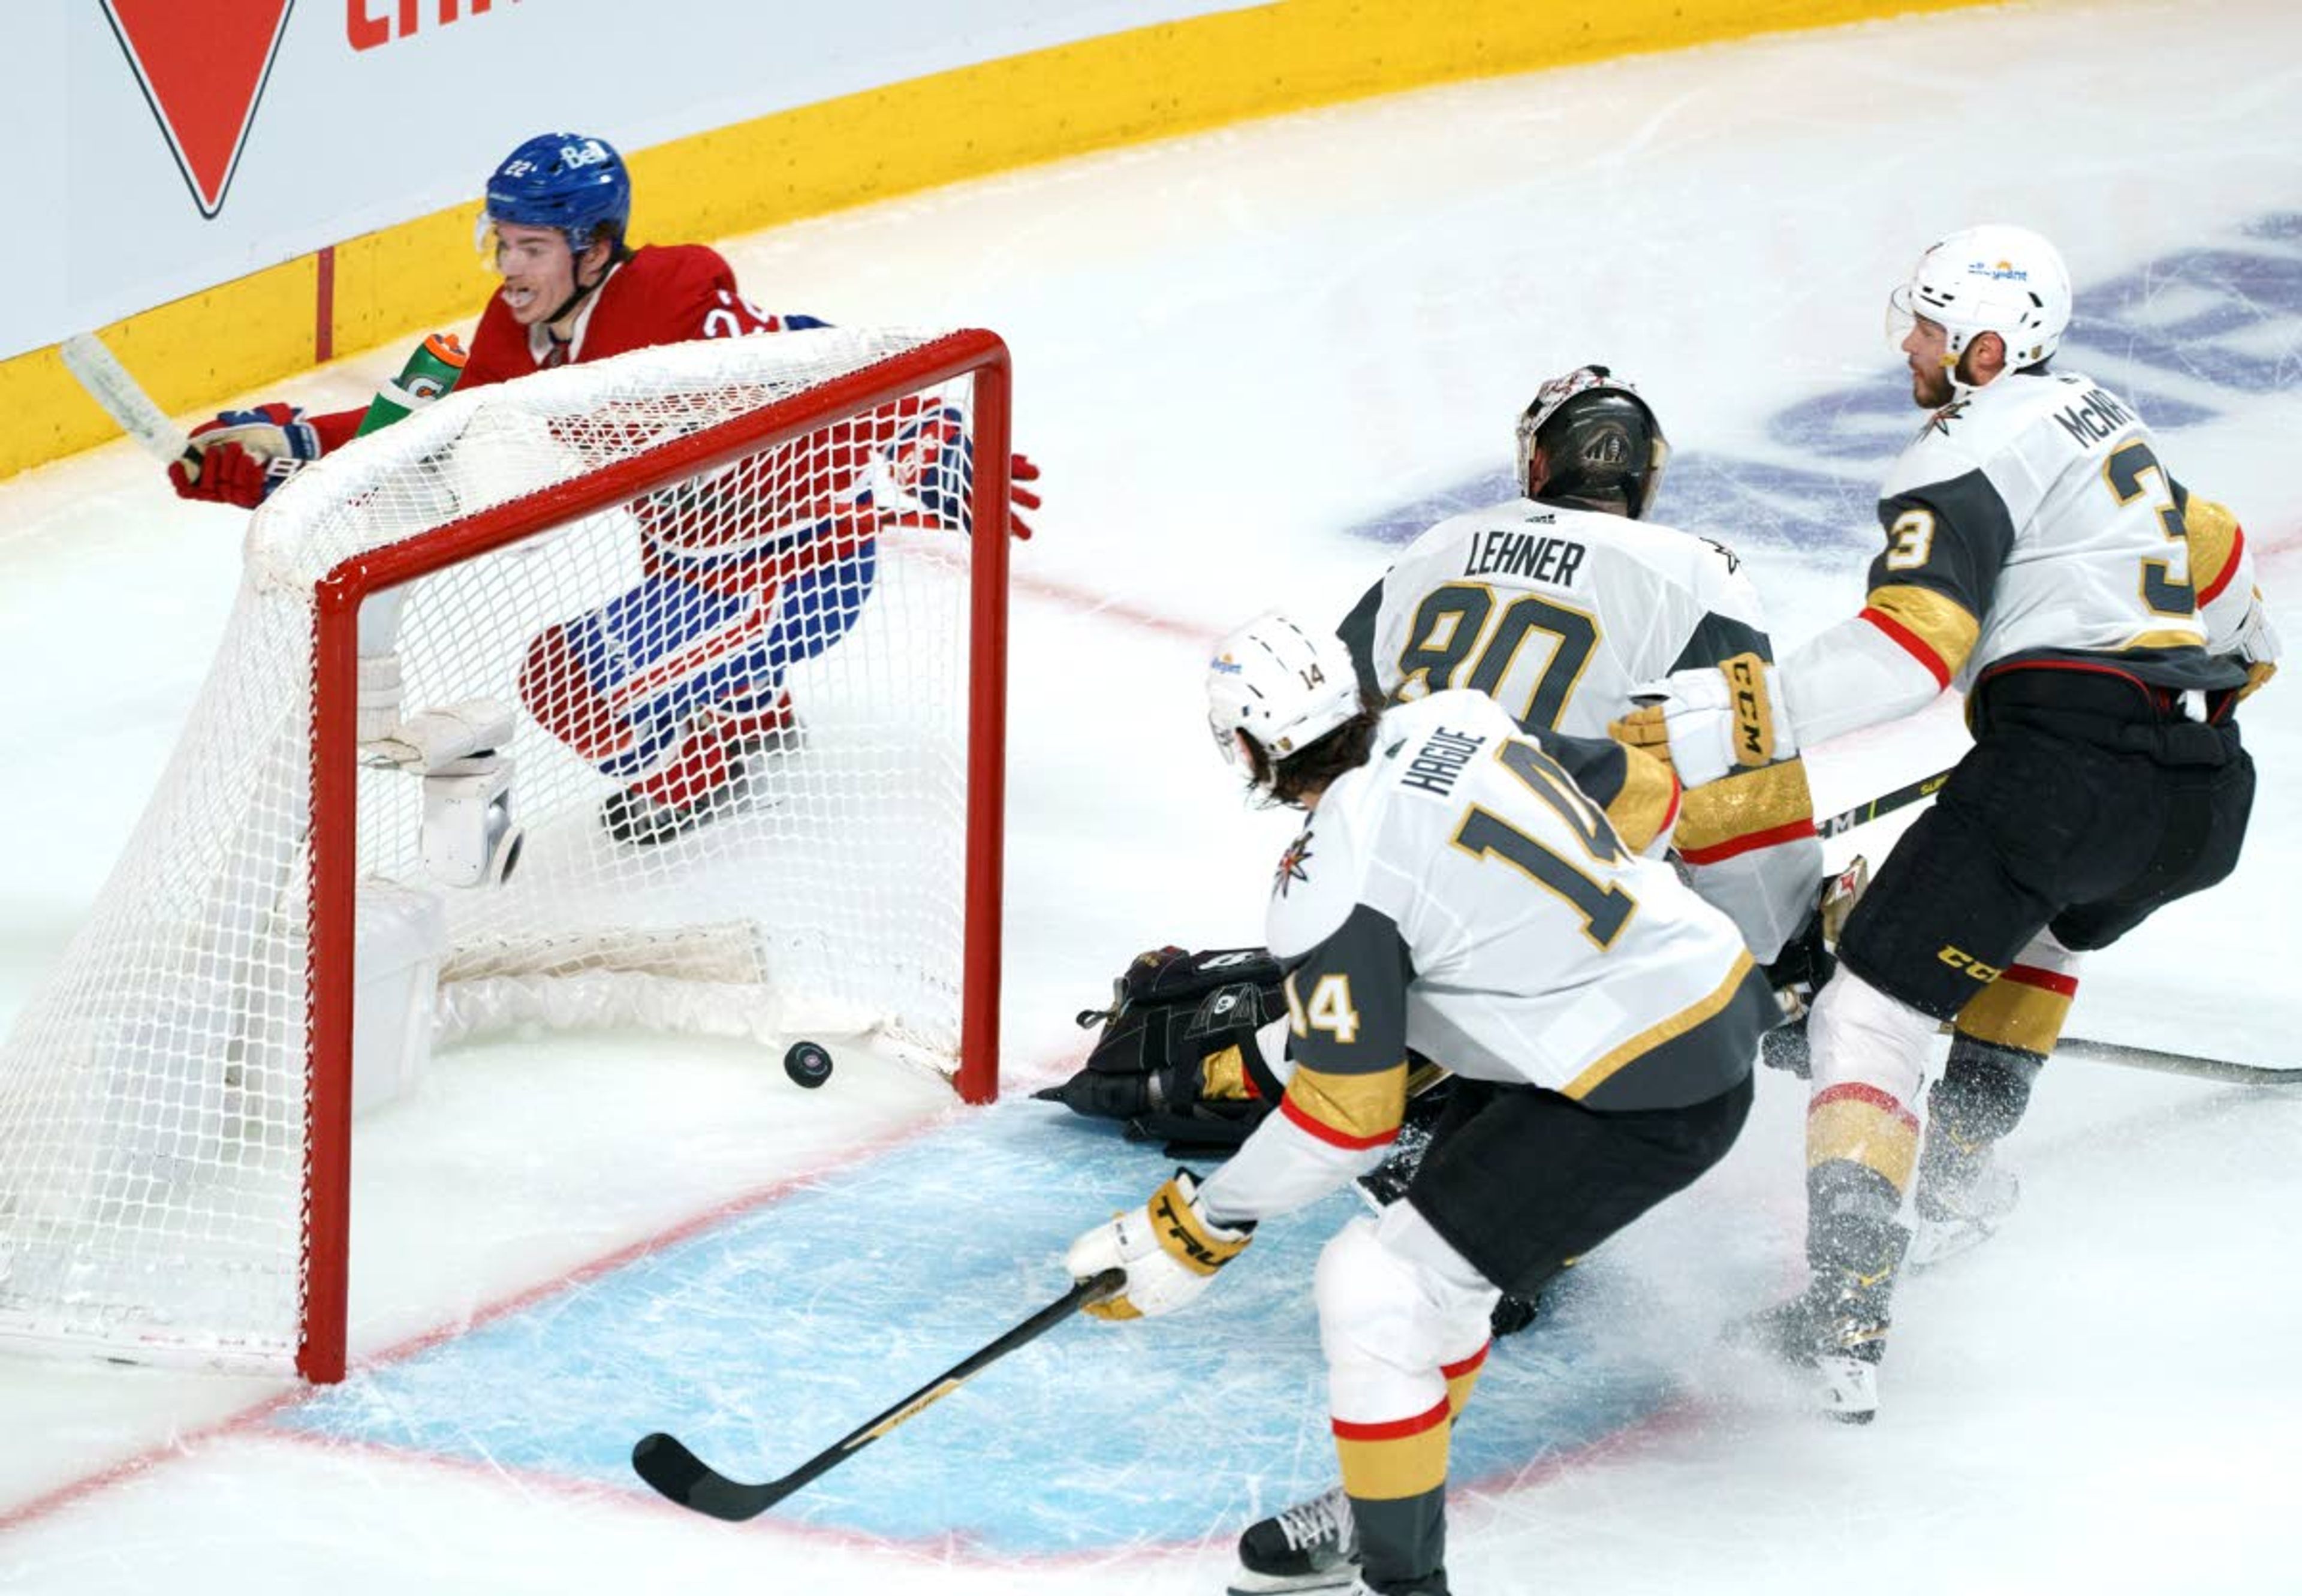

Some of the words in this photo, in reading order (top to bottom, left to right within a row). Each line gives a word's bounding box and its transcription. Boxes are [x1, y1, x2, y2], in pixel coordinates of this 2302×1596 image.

[504, 159, 532, 178] 22
[560, 140, 609, 170] Bell
[1464, 531, 1586, 588] LEHNER
[1887, 509, 1936, 571] 3
[2103, 438, 2194, 620] 3
[1299, 663, 1325, 691] 14
[1385, 581, 1603, 733] 90
[1733, 661, 1763, 754] CCM
[1400, 726, 1487, 797] HAGUE
[1447, 737, 1641, 953] 14
[1283, 969, 1360, 1043] 14
